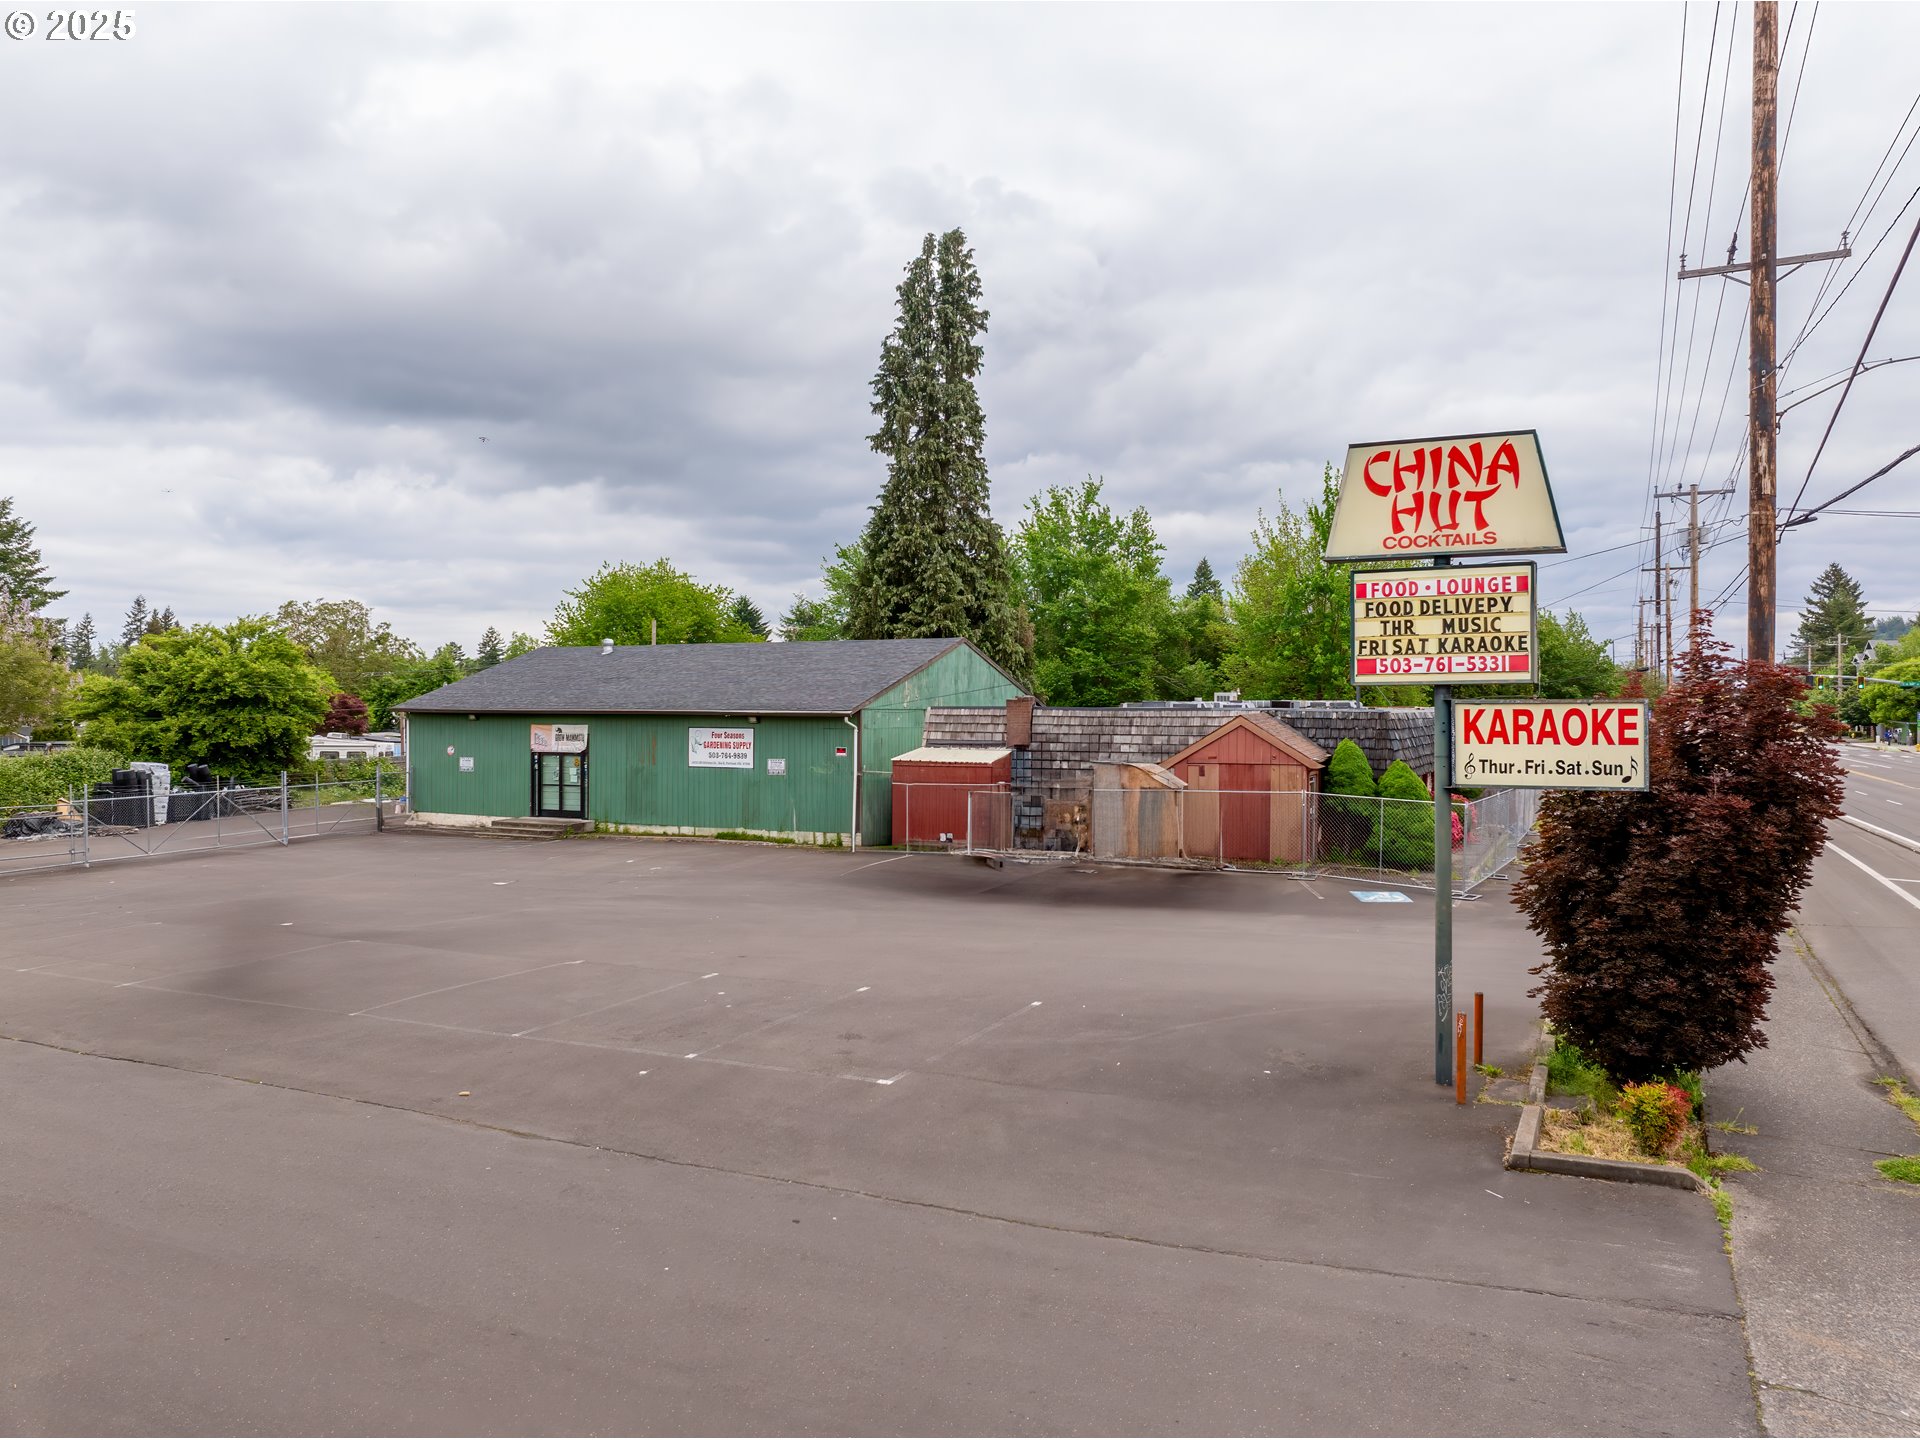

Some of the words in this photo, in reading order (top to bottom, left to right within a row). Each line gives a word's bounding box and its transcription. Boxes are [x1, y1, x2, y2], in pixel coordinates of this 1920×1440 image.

[1363, 438, 1520, 497] CHINA
[1391, 483, 1501, 534] HUT
[1382, 531, 1497, 549] COCKTAILS
[1371, 581, 1419, 598] FOOD
[1436, 576, 1512, 595] LOUNGE
[1365, 600, 1414, 617] FOOD
[1380, 619, 1415, 636] THR
[1442, 616, 1501, 634] MUSIC
[1437, 635, 1528, 654] KARAOKE
[1379, 655, 1507, 673] 503-761-5331
[724, 731, 745, 739] Seasons
[1463, 708, 1639, 746] KARAOKE
[703, 741, 731, 749] GARDENING
[732, 741, 752, 749] SUPPLY
[1592, 760, 1623, 776] Sun
